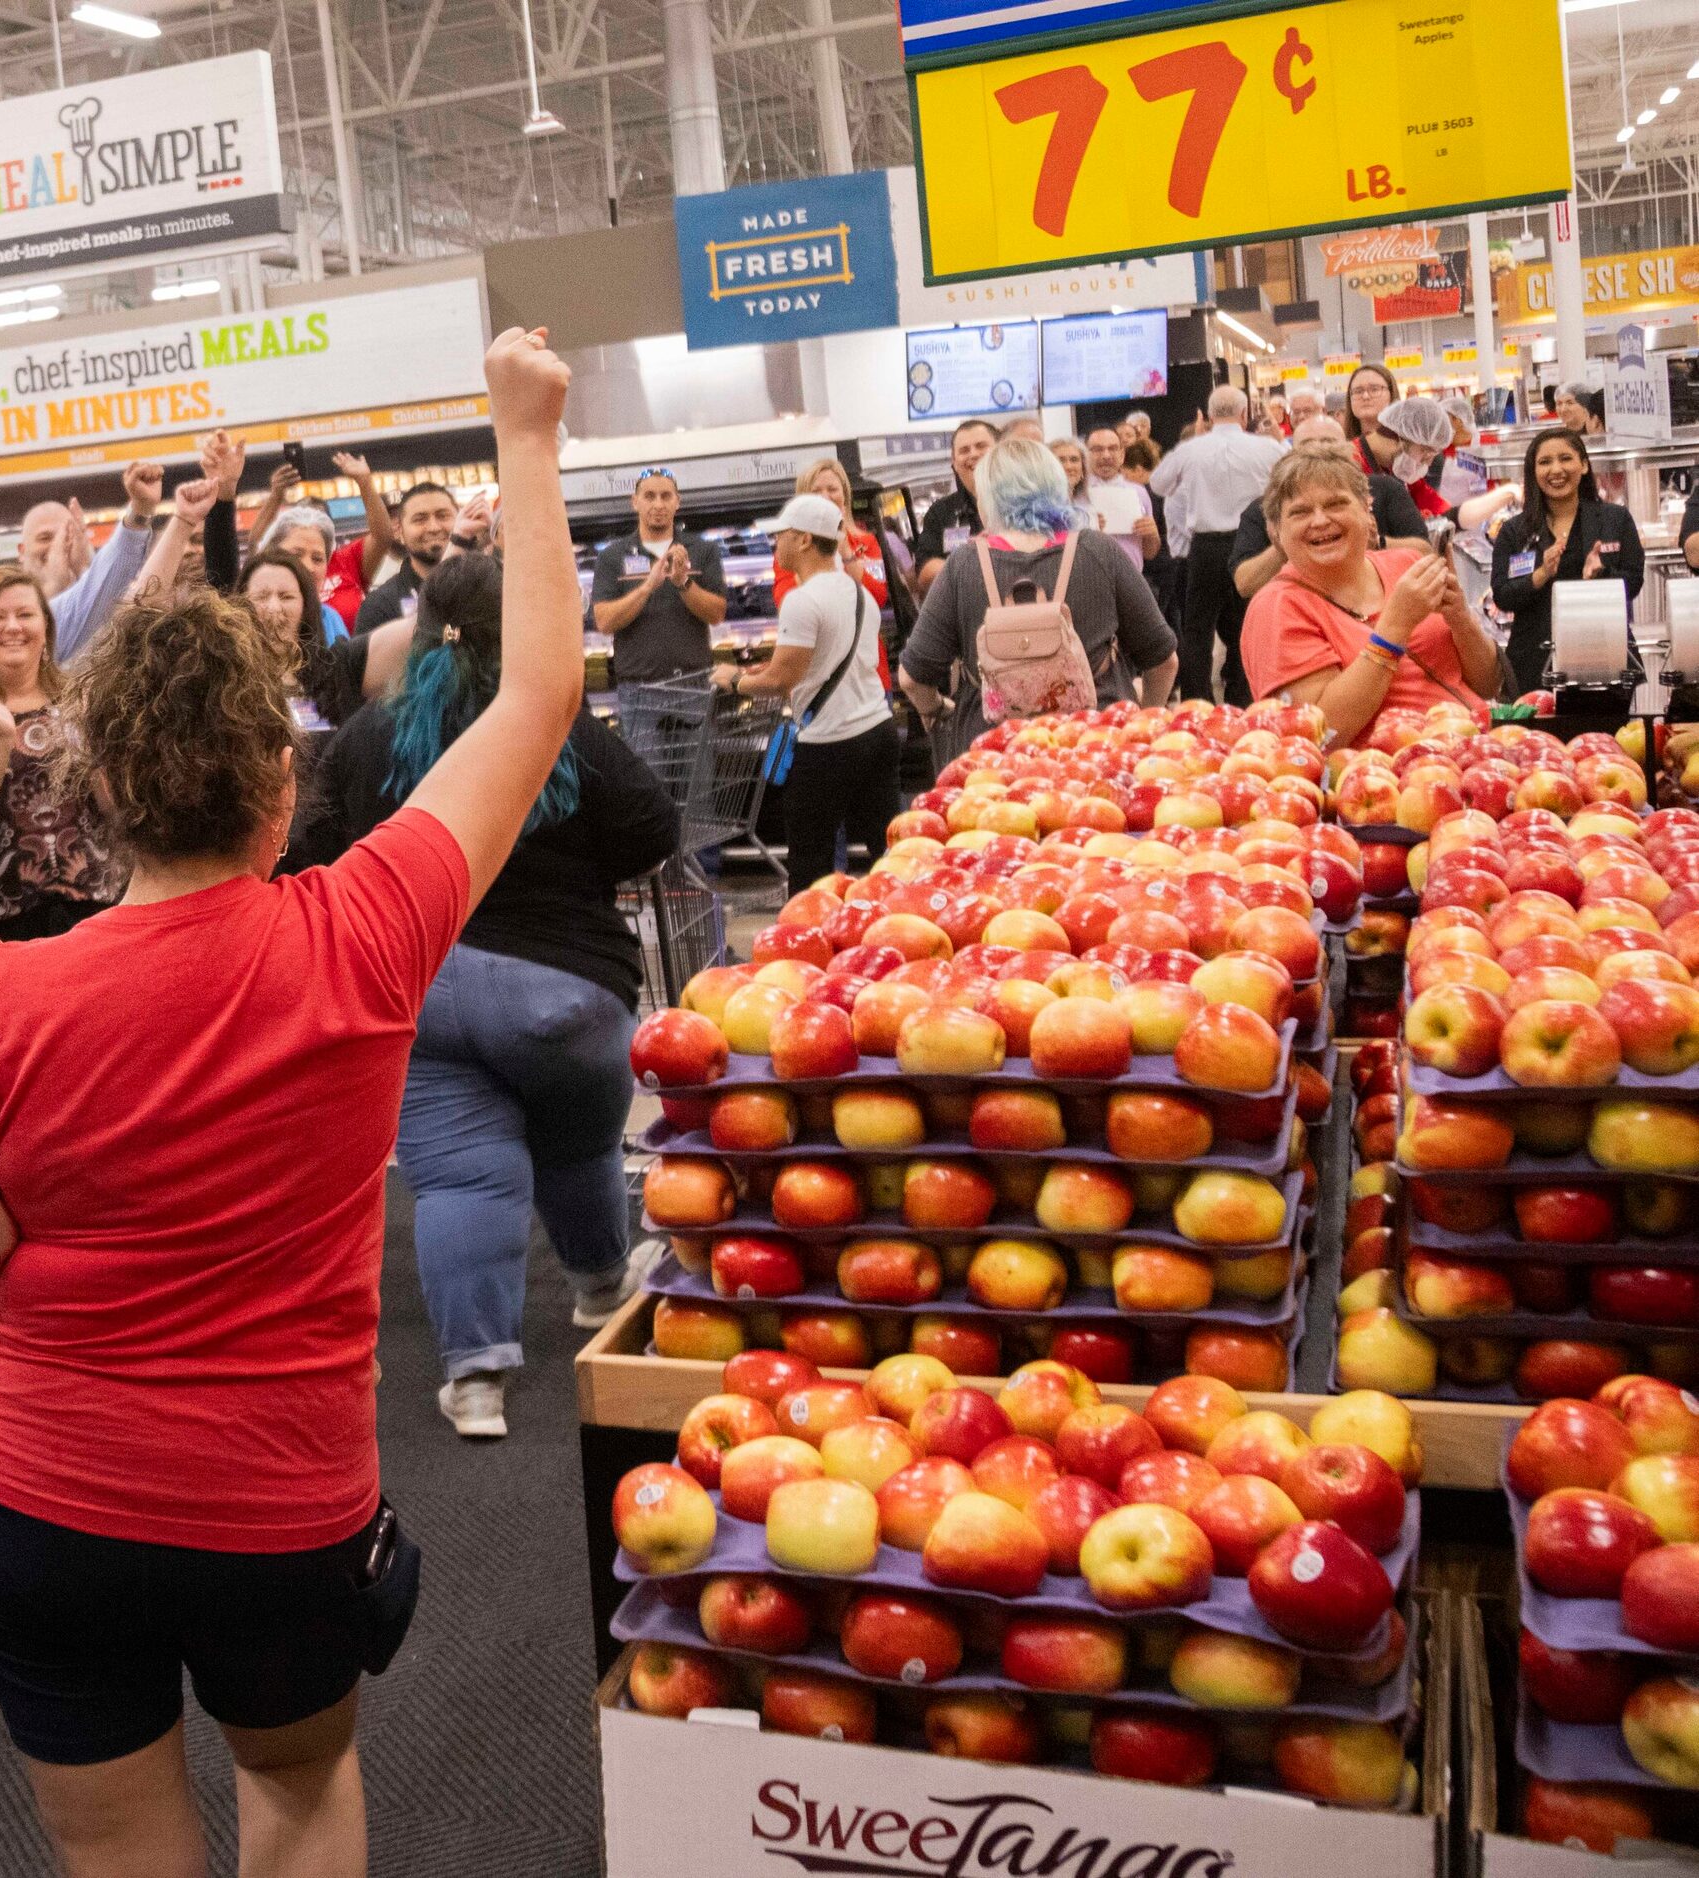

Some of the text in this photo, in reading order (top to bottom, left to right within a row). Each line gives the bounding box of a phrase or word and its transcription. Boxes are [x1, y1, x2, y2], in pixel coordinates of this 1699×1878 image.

[1398, 14, 1464, 31] Sweetango
[1414, 31, 1455, 45] Apples
[1407, 117, 1474, 136] PLU# 3603
[98, 119, 243, 195] SIMPLE
[1436, 148, 1448, 157] LB
[1347, 164, 1407, 202] LB.
[92, 225, 144, 247] meals
[145, 222, 162, 238] in
[163, 210, 235, 234] minutes.
[743, 208, 808, 232] MADE
[726, 244, 833, 280] FRESH
[947, 277, 1135, 303] SUSHI HOUSE
[744, 293, 821, 316] TODAY
[15, 332, 195, 396] chef-inspired
[200, 312, 330, 369] MEALS
[1, 380, 227, 445] IN MINUTES.
